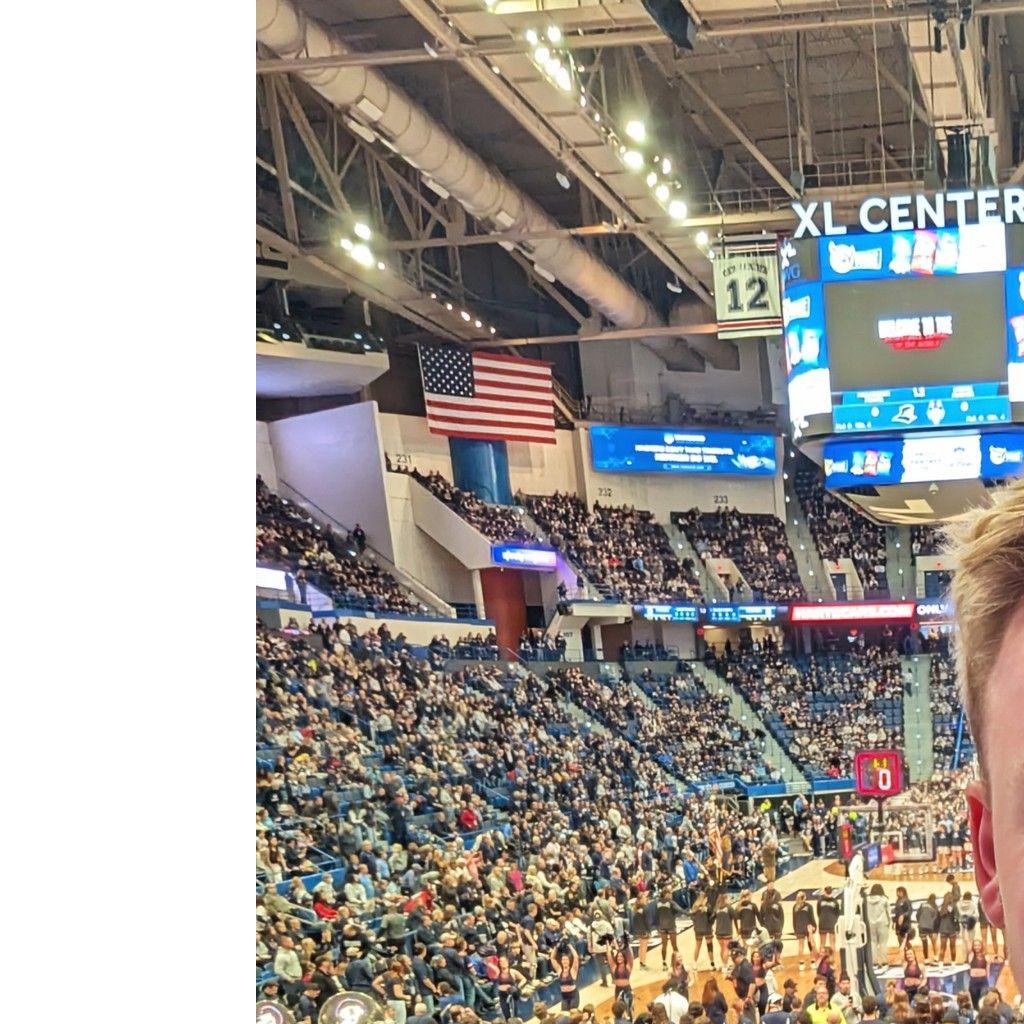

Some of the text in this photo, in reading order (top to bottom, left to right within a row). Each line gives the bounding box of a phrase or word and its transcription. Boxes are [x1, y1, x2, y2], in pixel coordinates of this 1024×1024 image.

[791, 201, 847, 238] XL
[726, 278, 769, 313] 12
[879, 768, 892, 790] 0
